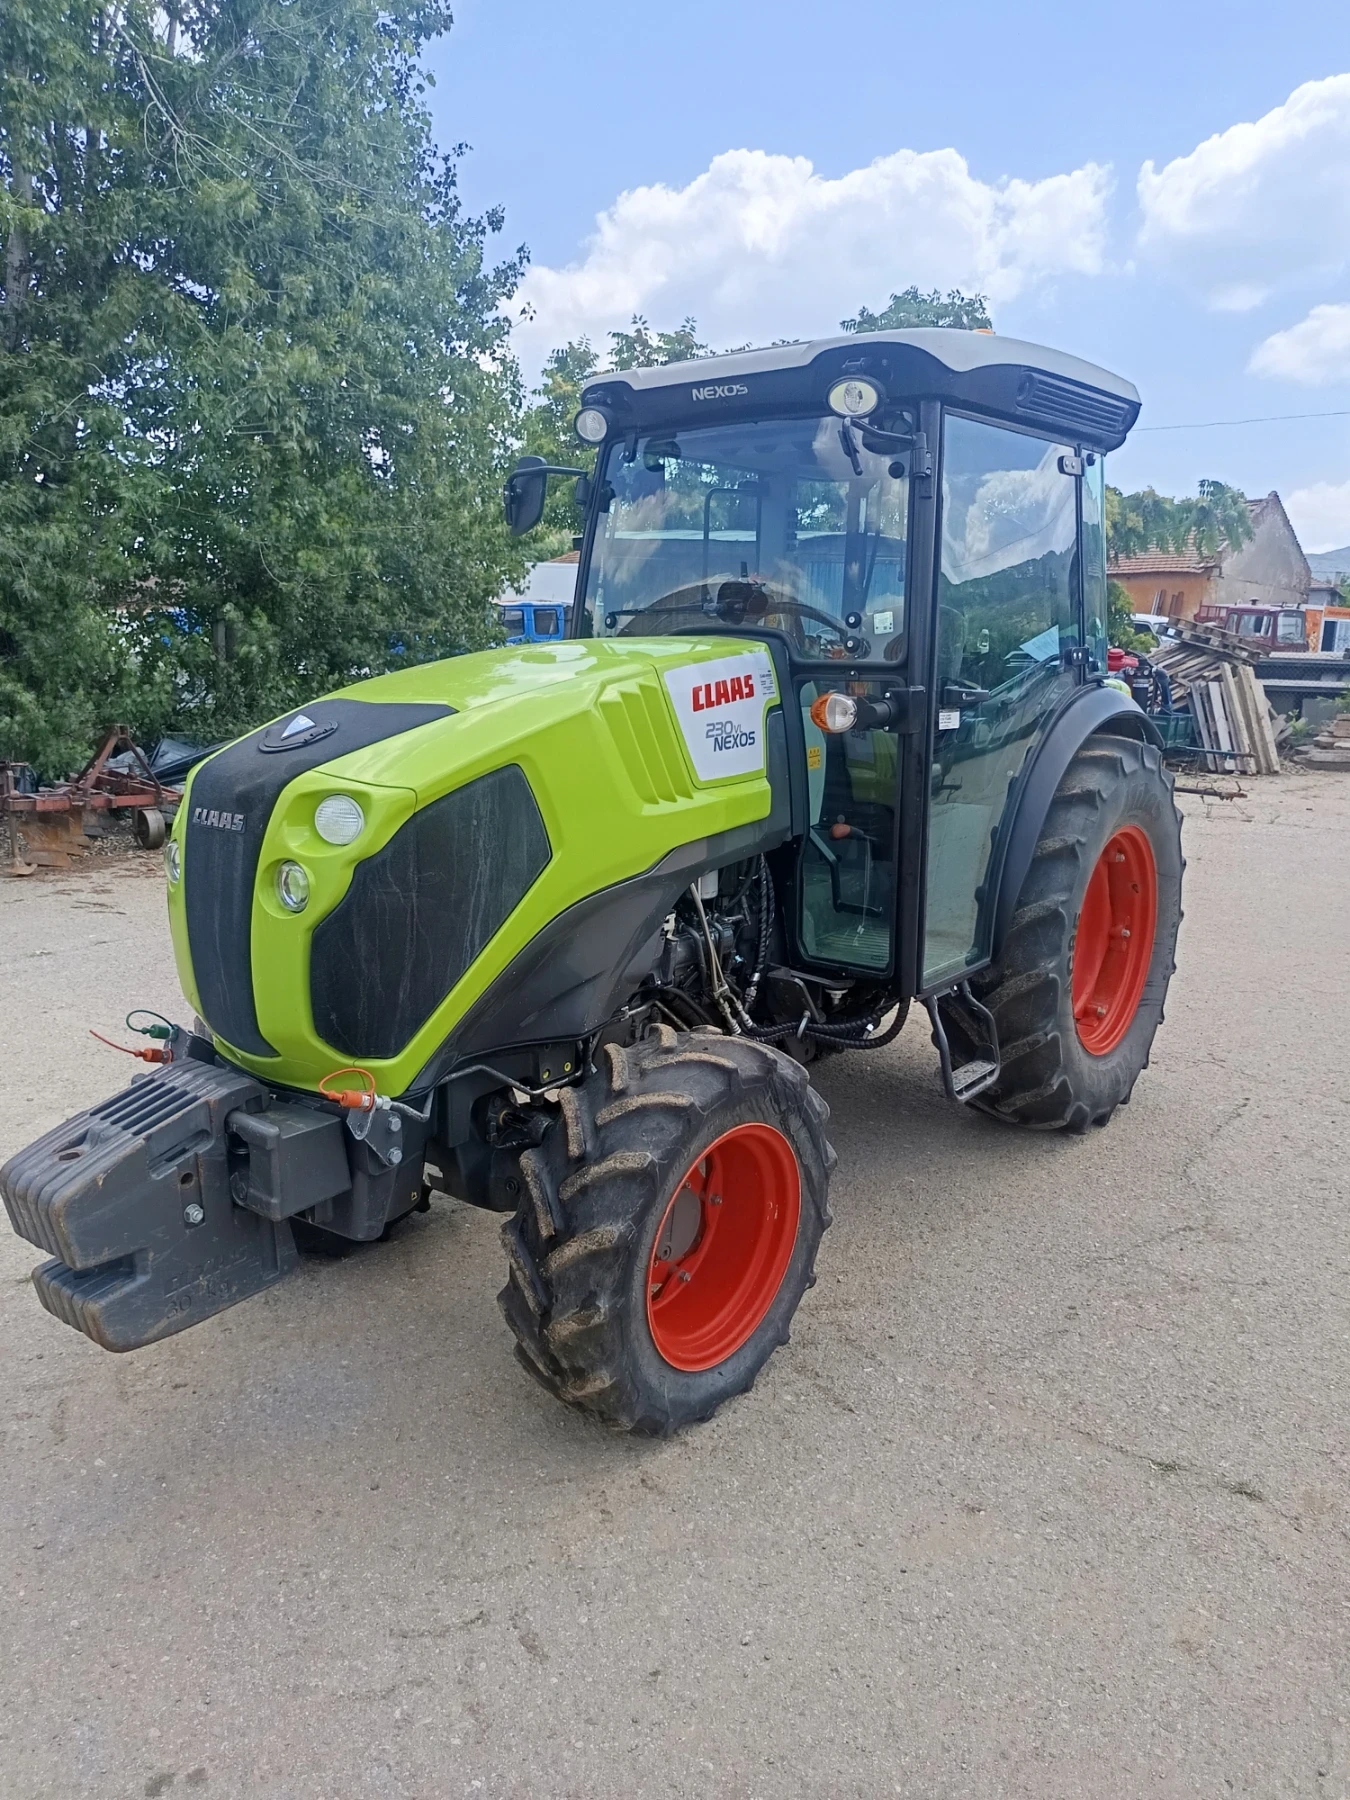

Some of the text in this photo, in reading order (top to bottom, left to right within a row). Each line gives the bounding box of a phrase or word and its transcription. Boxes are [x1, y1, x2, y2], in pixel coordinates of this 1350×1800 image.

[691, 383, 748, 401] NEXOS
[692, 674, 755, 712] CLAAS
[705, 720, 733, 739] 230
[713, 731, 756, 752] NEXOS
[192, 807, 245, 831] CLAAS
